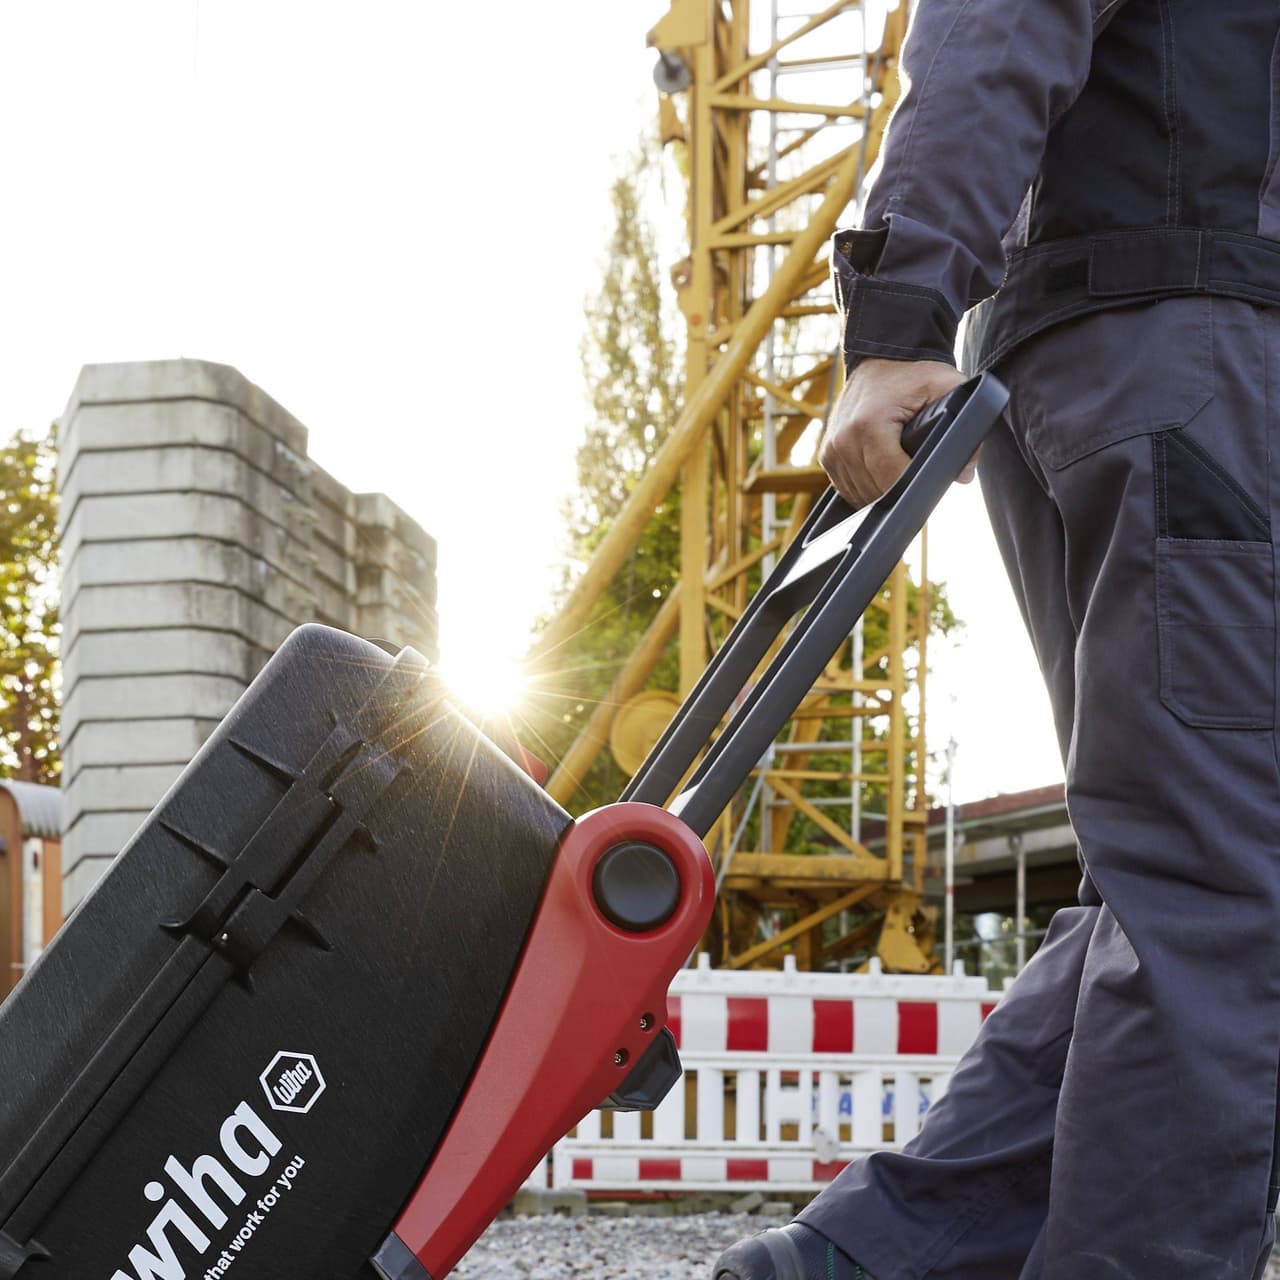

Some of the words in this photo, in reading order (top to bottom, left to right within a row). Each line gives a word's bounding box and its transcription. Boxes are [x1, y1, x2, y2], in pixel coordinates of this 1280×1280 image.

[273, 1061, 313, 1105] Wiha
[230, 1209, 265, 1252] work
[257, 1185, 282, 1213] for
[279, 1154, 306, 1191] you
